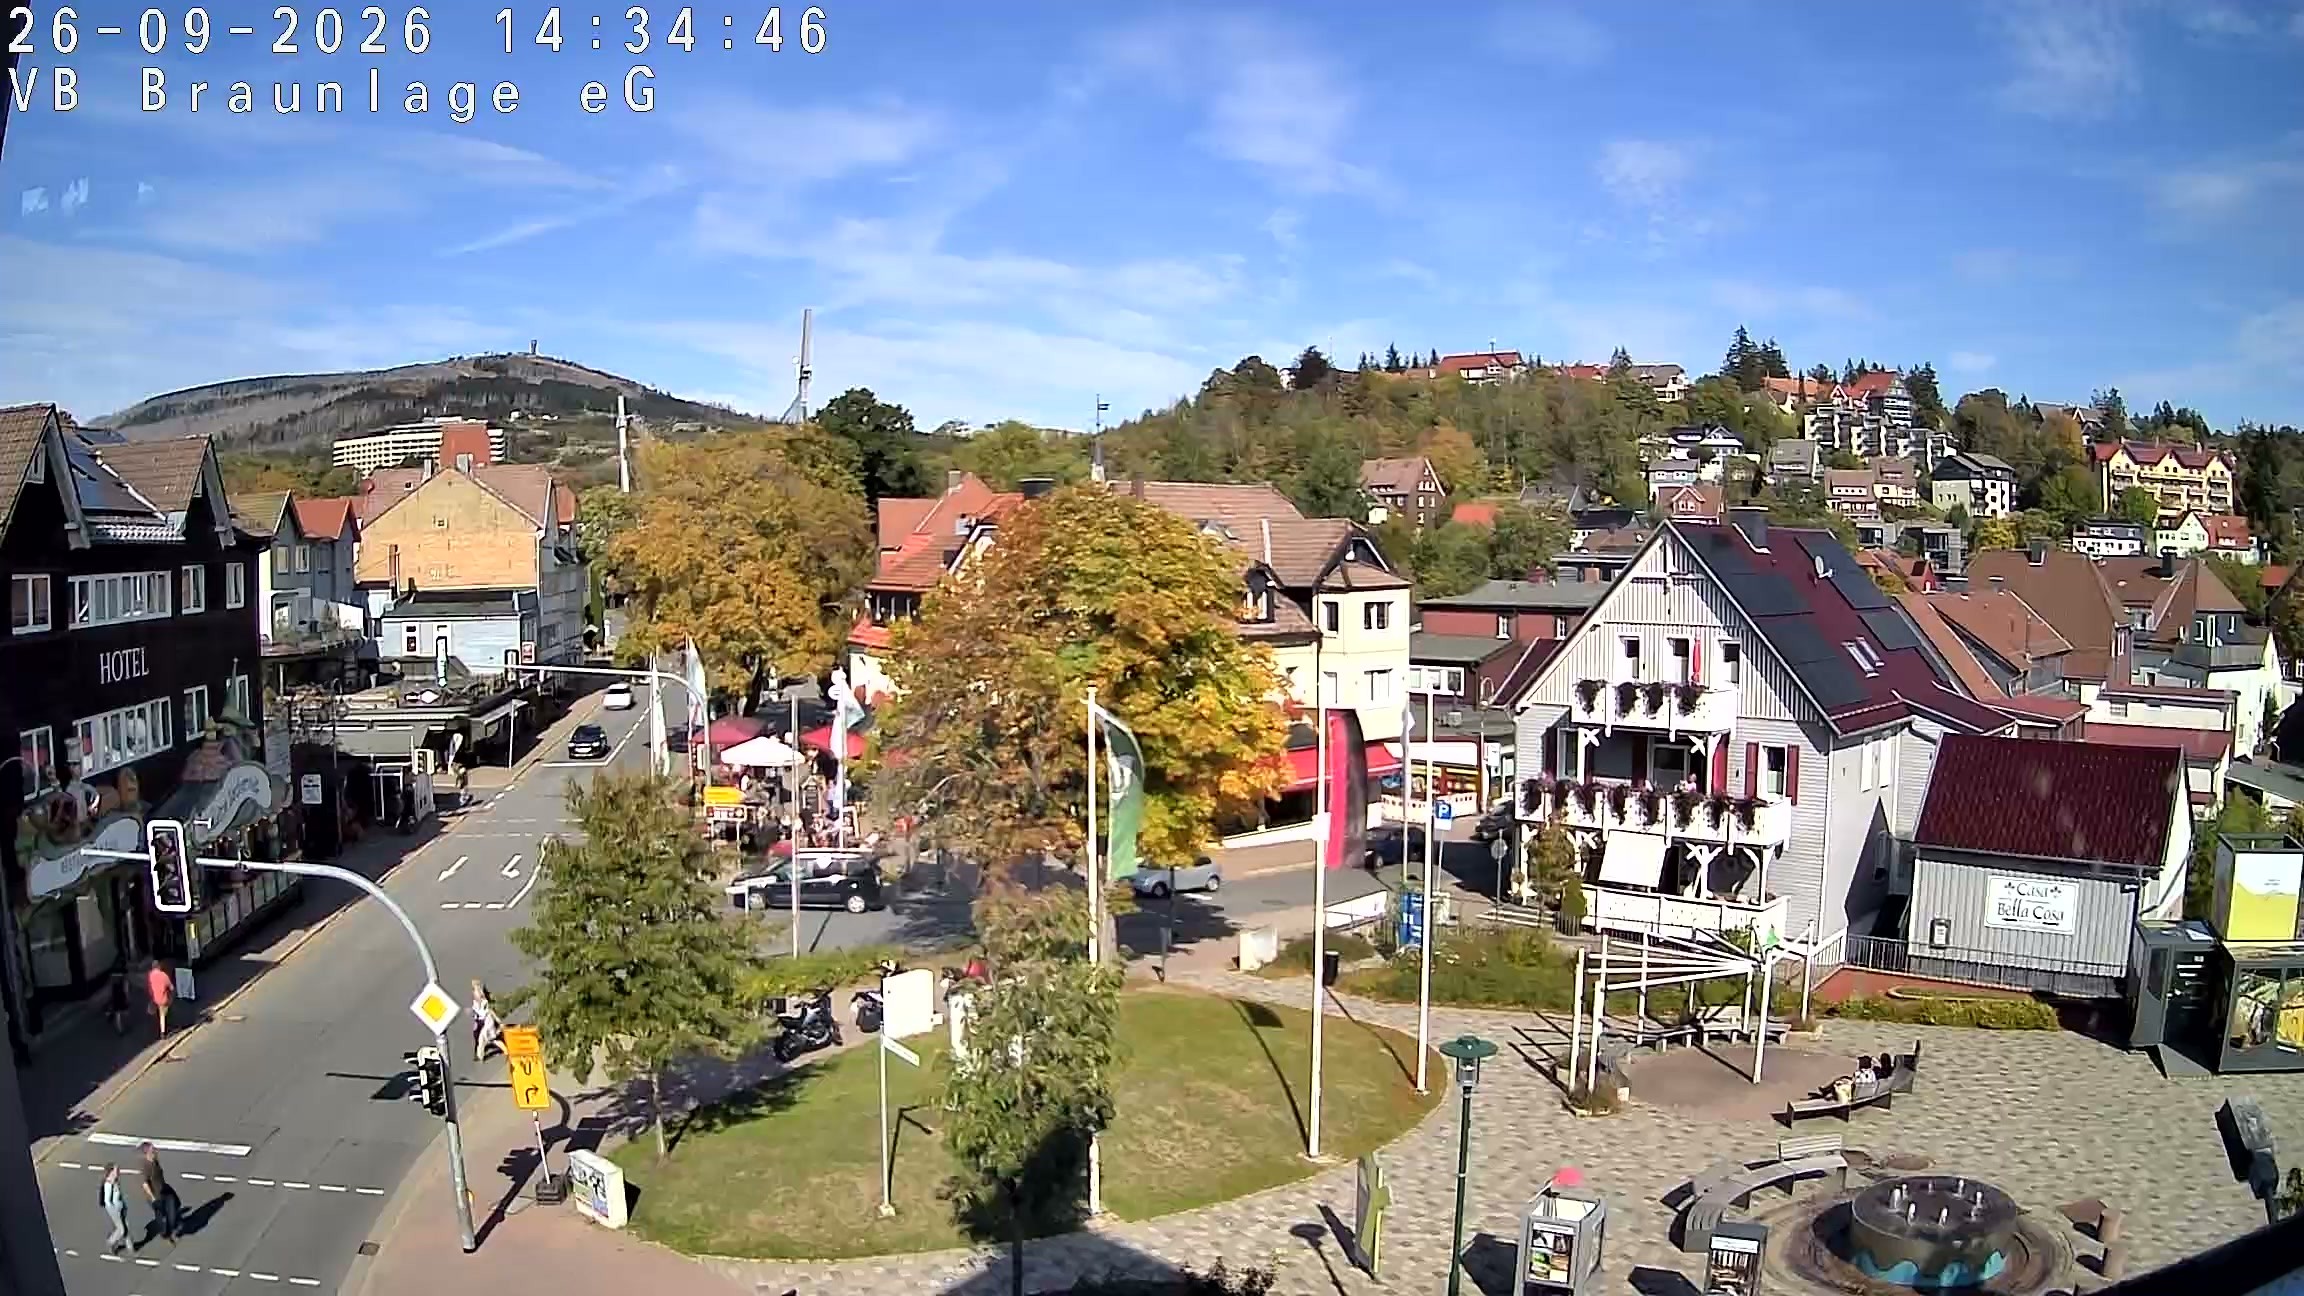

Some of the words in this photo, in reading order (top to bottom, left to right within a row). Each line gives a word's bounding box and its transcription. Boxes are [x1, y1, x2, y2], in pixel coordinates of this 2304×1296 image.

[100, 647, 150, 684] HOTEL
[2016, 882, 2049, 898] Casa
[1997, 897, 2029, 918] Bella
[2032, 905, 2065, 921] Cosa
